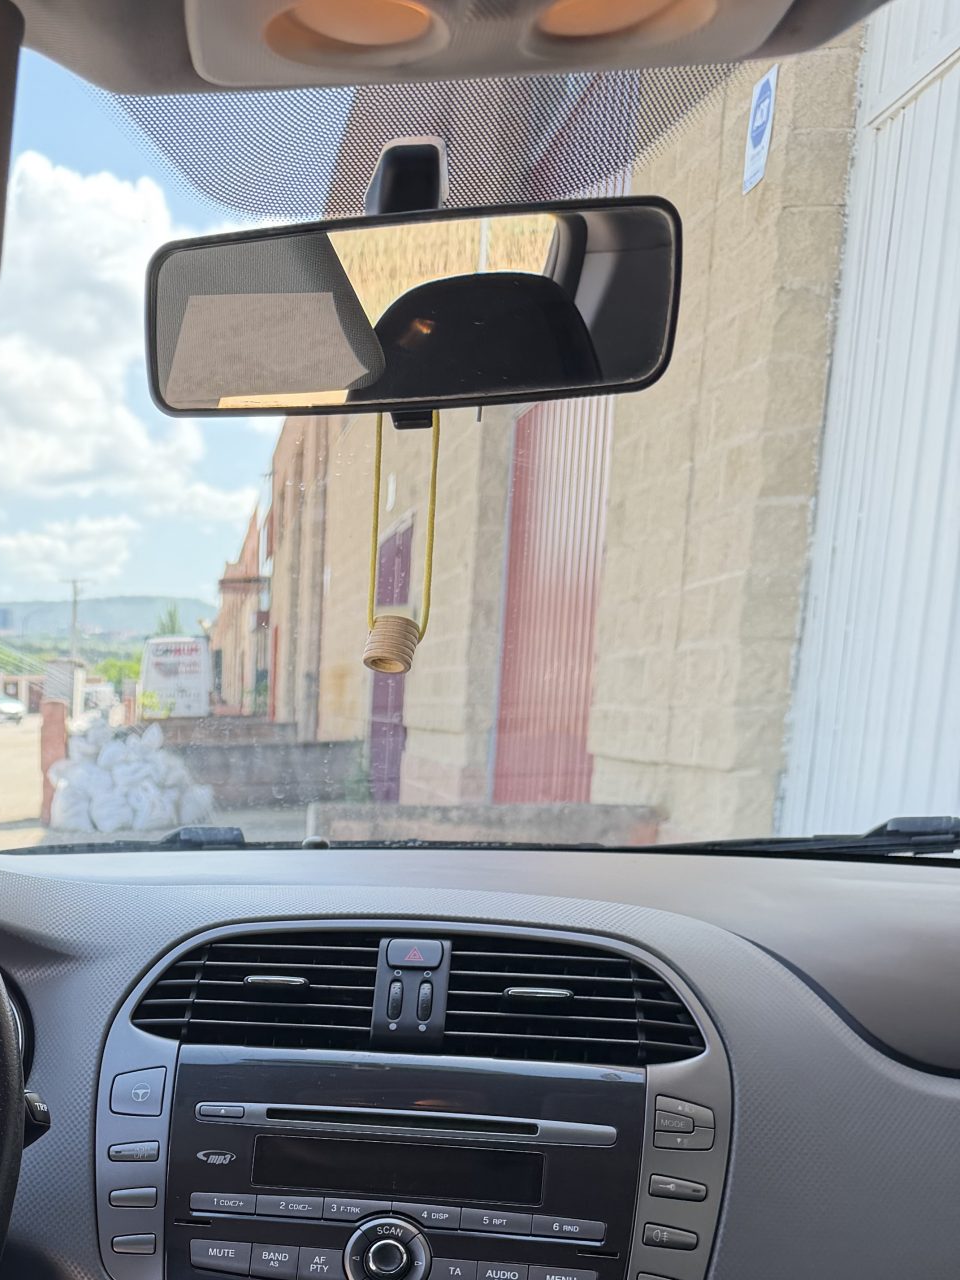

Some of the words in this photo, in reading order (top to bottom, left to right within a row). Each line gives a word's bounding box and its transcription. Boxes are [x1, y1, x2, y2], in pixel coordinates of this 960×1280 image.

[661, 1119, 687, 1129] MODE
[279, 1201, 286, 1210] 2
[330, 1204, 338, 1213] 3
[421, 1210, 428, 1219] 4
[431, 1212, 449, 1221] DISP
[482, 1217, 489, 1225] 5
[492, 1218, 508, 1226] RPT
[376, 1225, 404, 1238] SCAN
[552, 1222, 560, 1231] 6
[562, 1225, 580, 1233] RND
[208, 1247, 236, 1258] MUTE
[261, 1251, 289, 1262] BAND
[269, 1260, 279, 1268] AS
[313, 1255, 327, 1265] AF
[309, 1263, 329, 1274] PTY
[448, 1266, 462, 1276] TA
[485, 1268, 519, 1280] AUDIO
